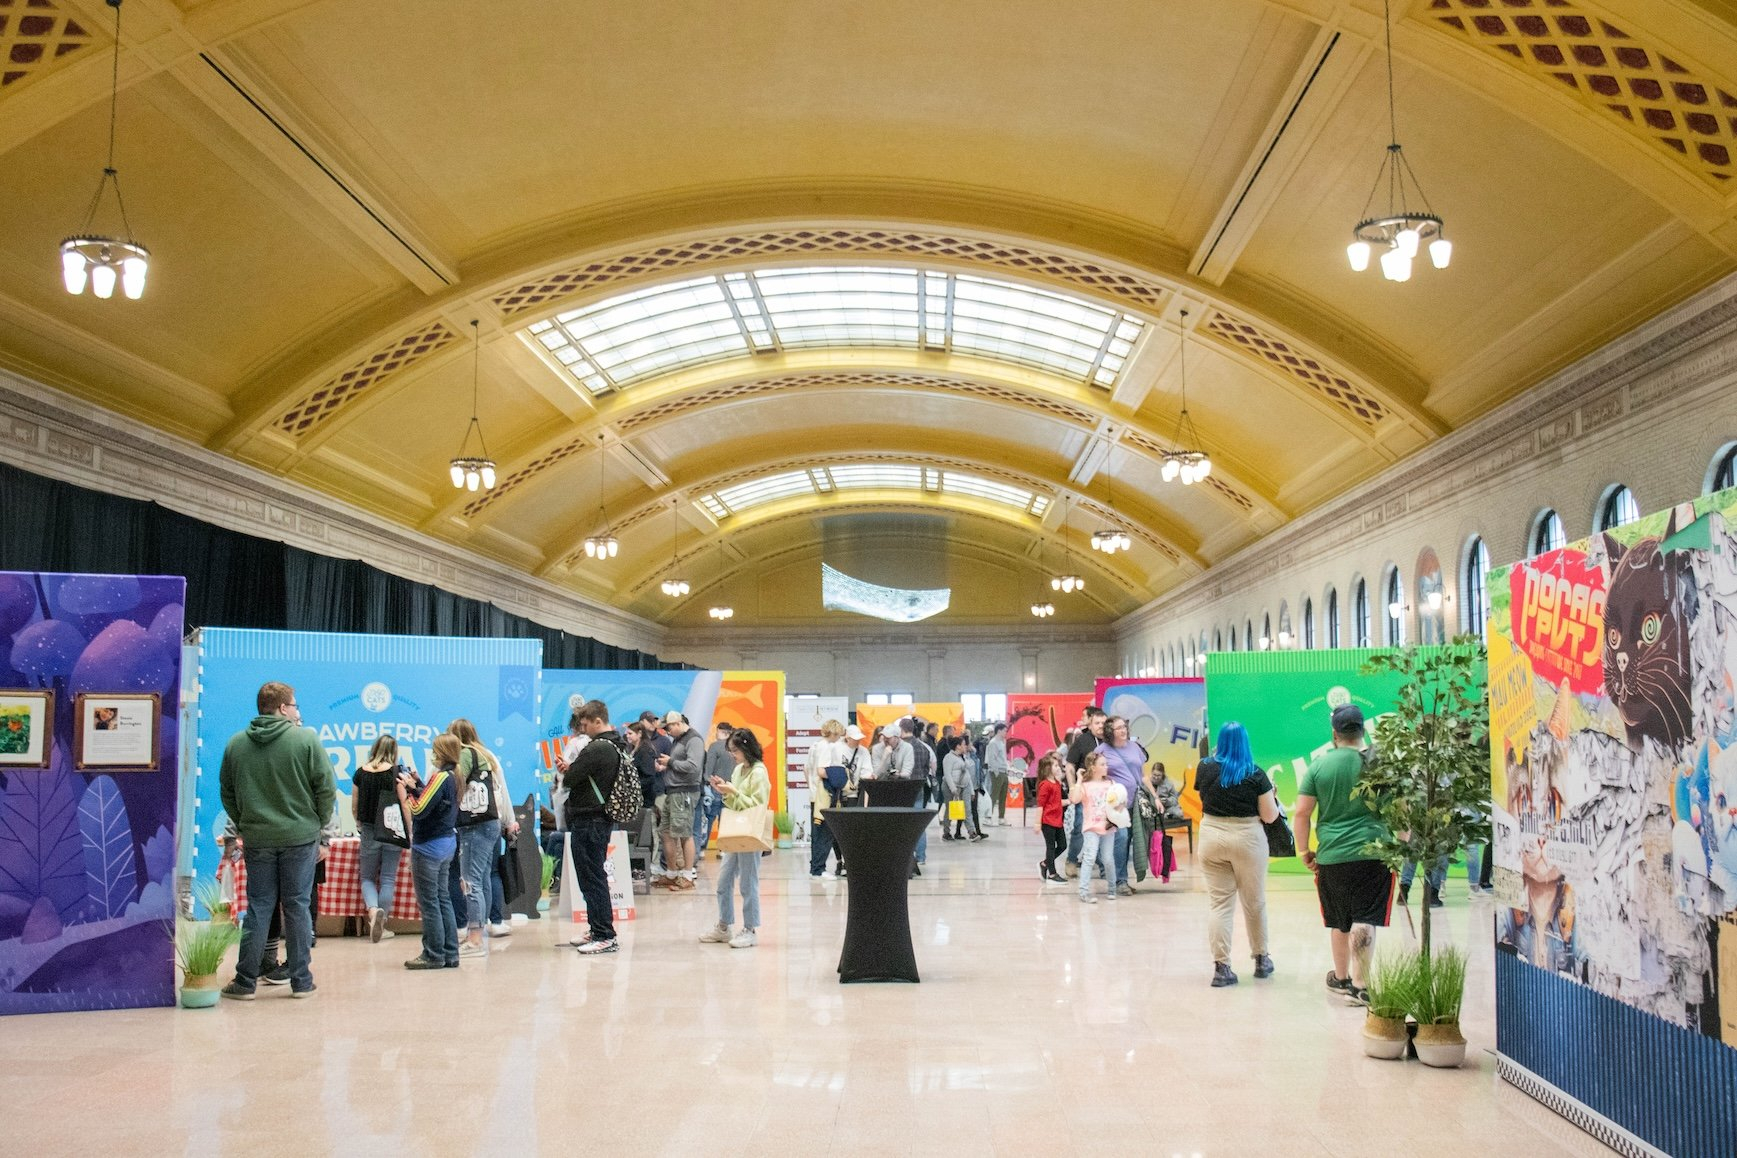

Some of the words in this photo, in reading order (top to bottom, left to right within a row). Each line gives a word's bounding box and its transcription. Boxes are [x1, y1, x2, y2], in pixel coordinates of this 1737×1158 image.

[329, 694, 360, 710] PREMIUM
[392, 694, 420, 710] QUALITY
[1170, 723, 1199, 749] FI
